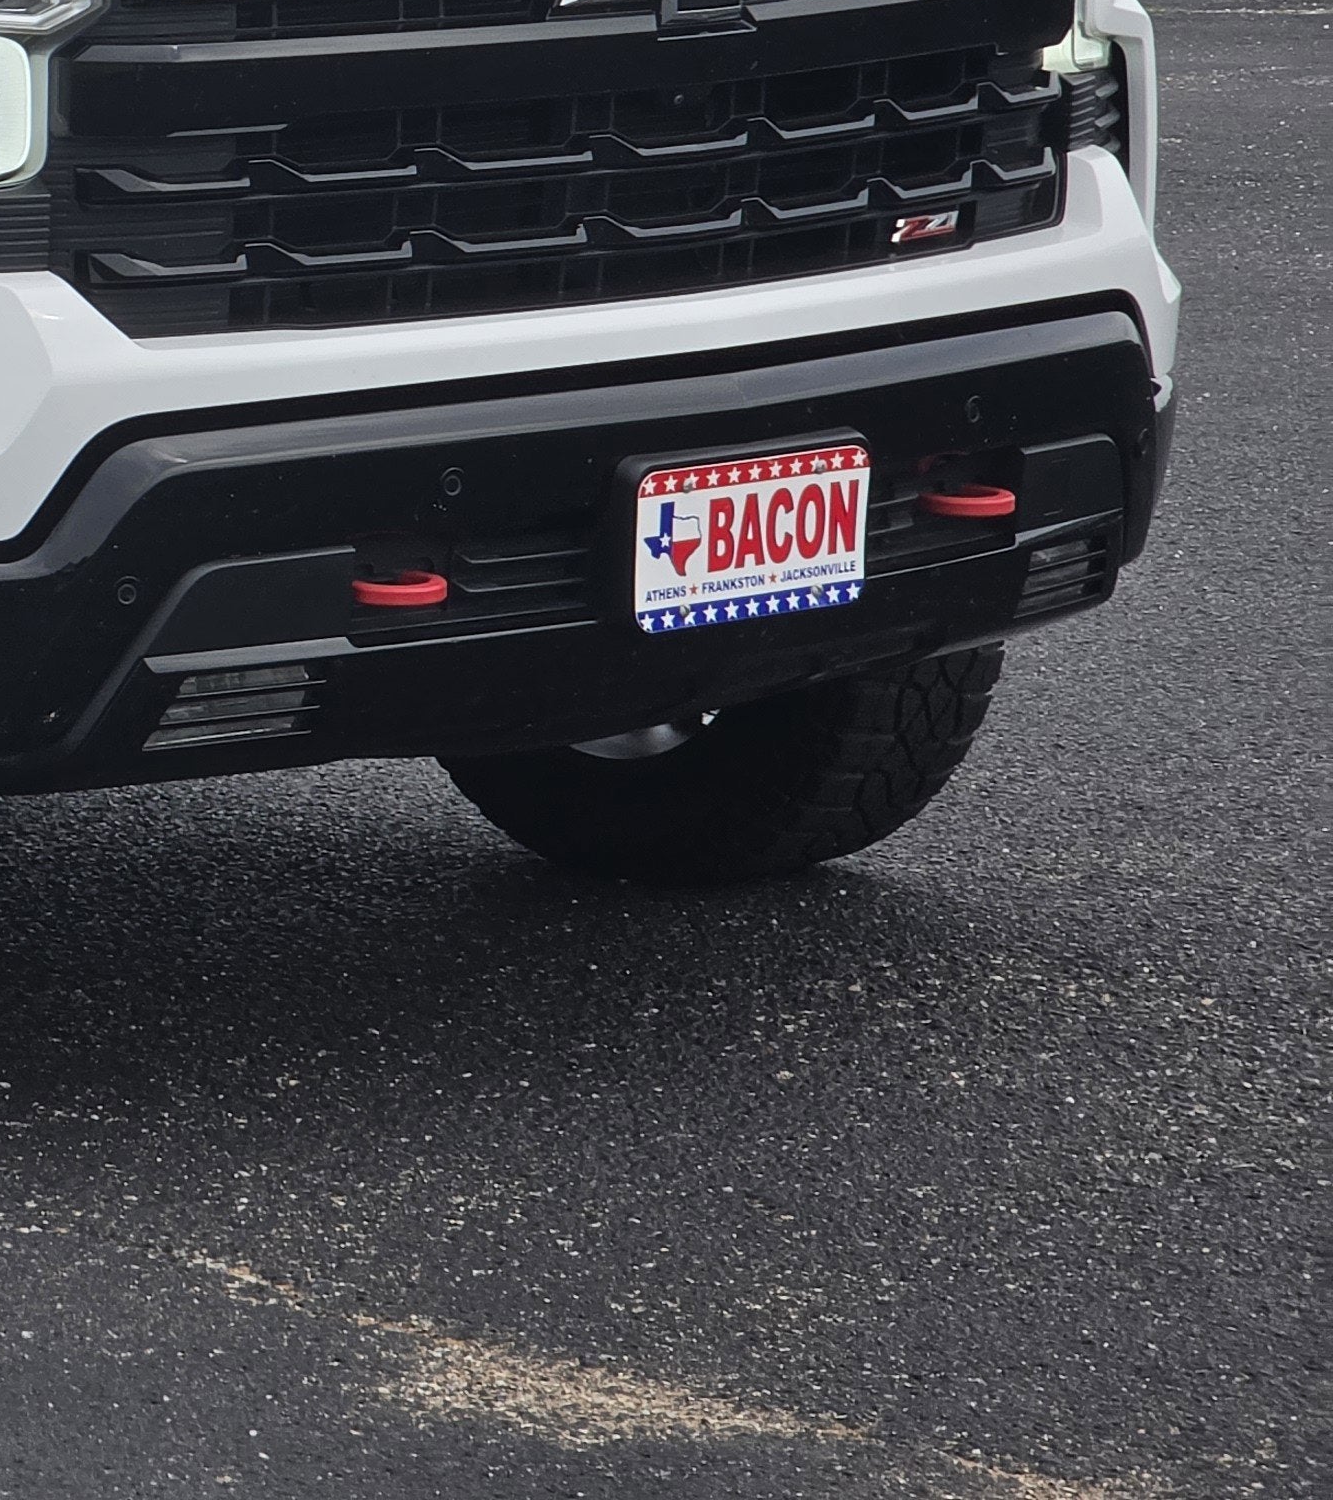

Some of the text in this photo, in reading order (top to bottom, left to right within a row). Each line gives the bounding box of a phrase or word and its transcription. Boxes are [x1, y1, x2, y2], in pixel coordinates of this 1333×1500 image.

[707, 479, 859, 573] BACON
[645, 559, 857, 603] ATHENS FRANKSTON JACKSONVILLE
